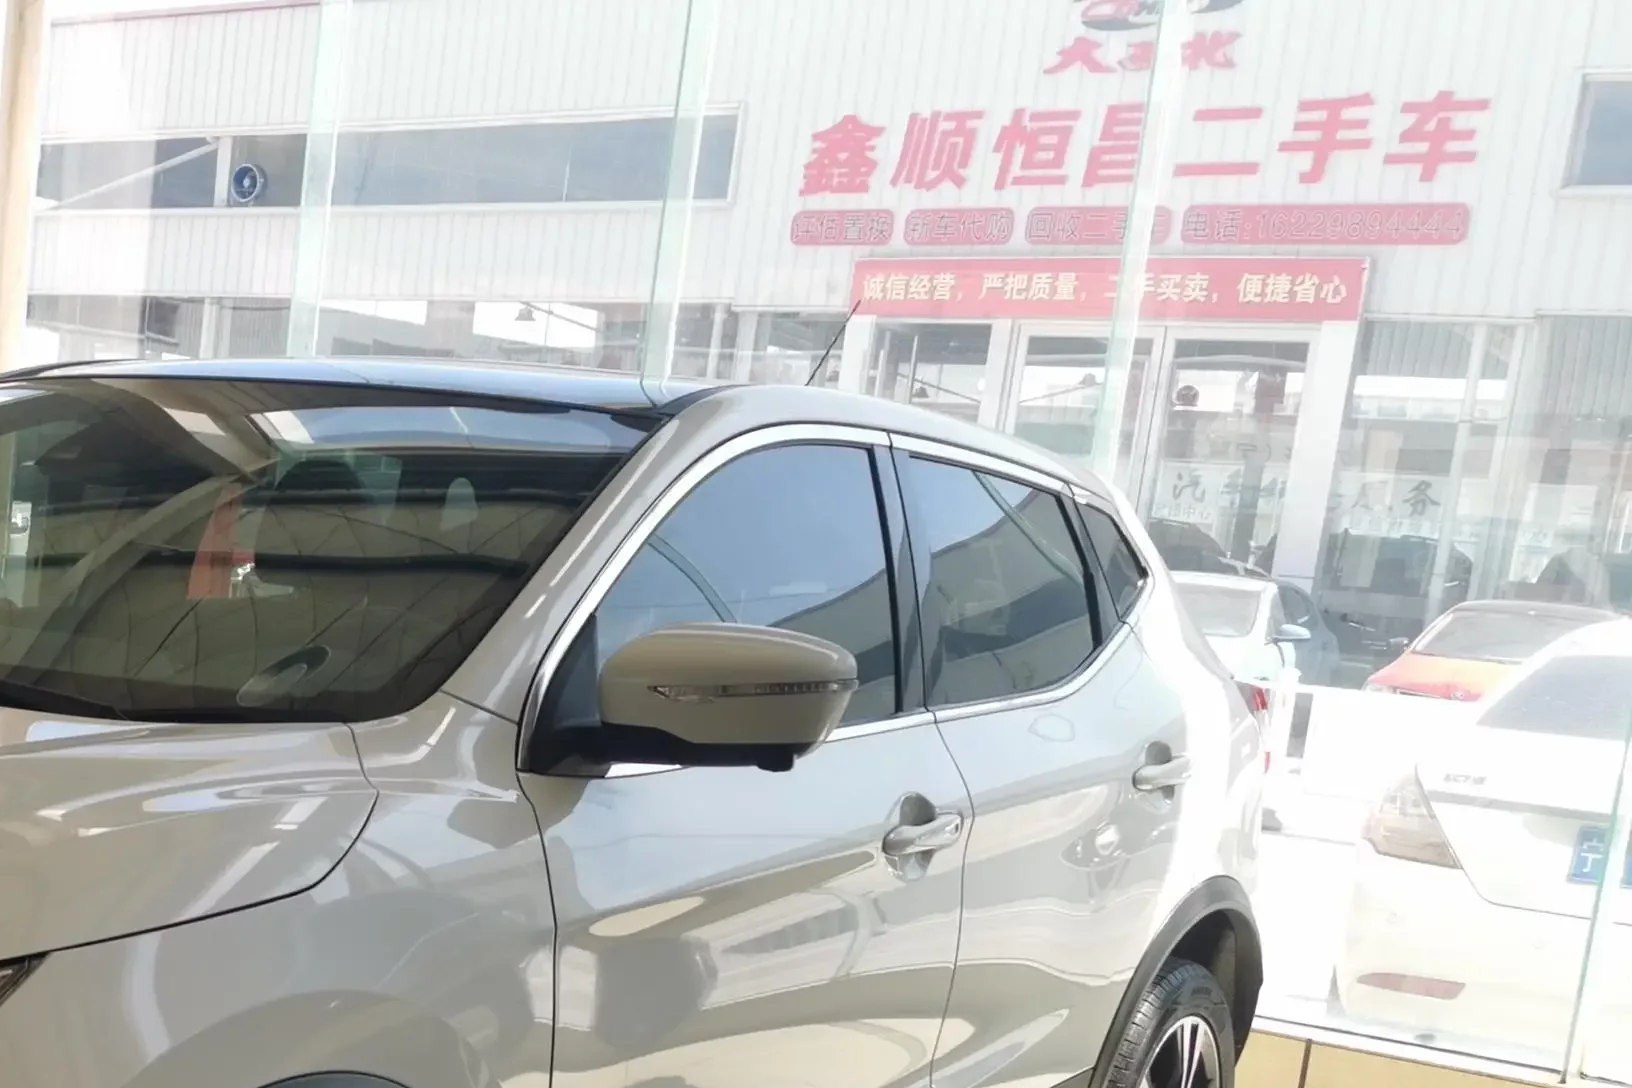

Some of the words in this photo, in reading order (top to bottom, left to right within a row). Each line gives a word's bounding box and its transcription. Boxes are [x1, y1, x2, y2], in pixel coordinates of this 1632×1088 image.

[798, 89, 1492, 197] 鑫顺恒昌二手车
[793, 211, 891, 242] 评估置换
[908, 211, 1010, 241] 新车代购
